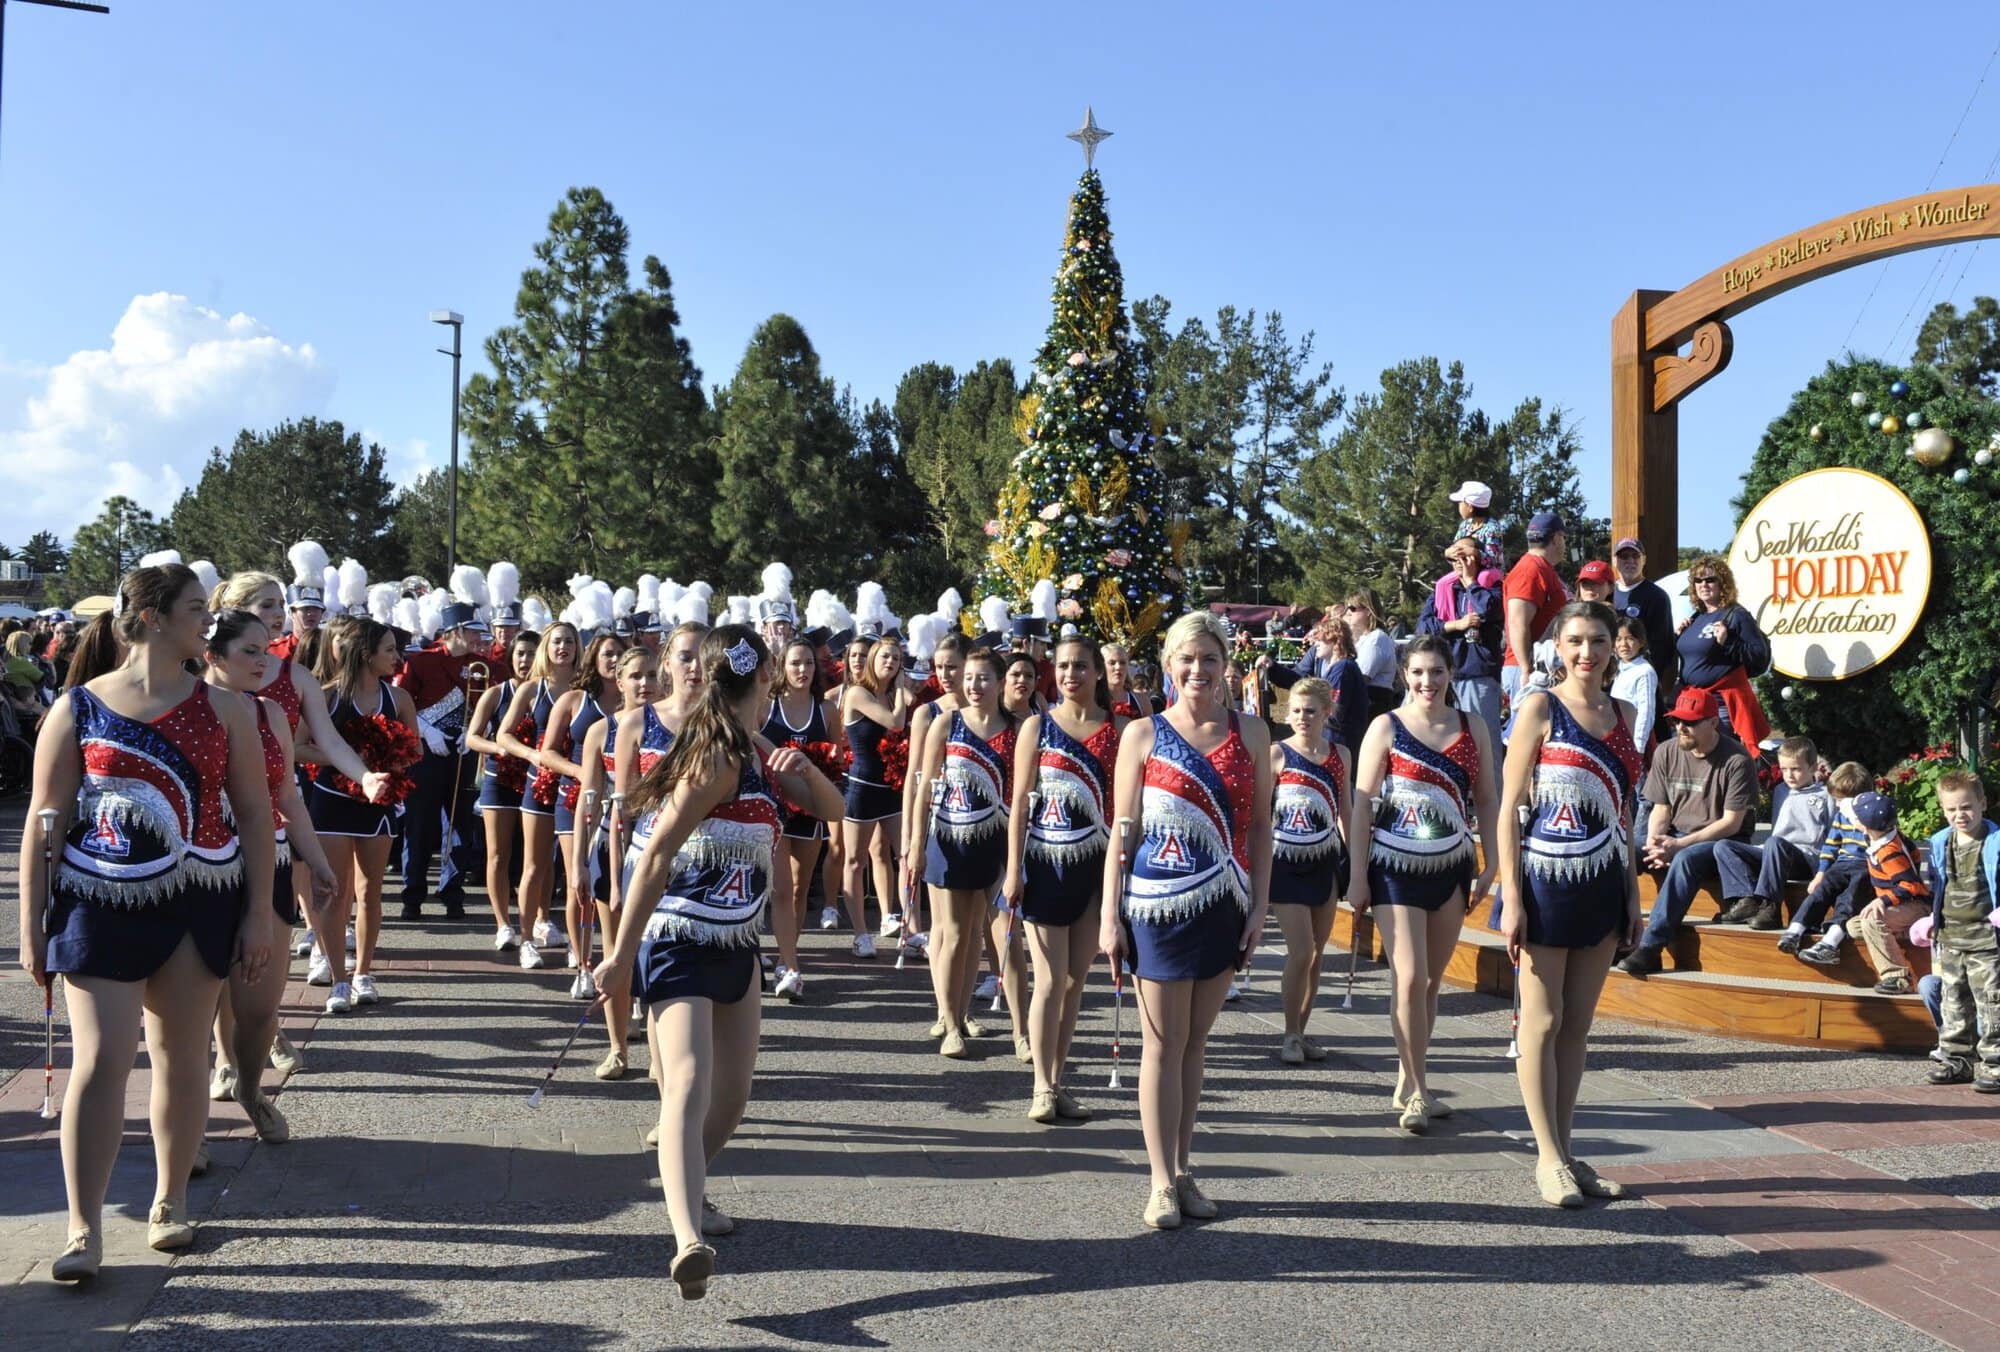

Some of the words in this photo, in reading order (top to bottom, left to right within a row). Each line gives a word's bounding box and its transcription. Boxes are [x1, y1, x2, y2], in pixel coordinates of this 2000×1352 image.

[1721, 264, 1762, 294] Hope
[1777, 237, 1830, 268] Believe
[1849, 212, 1893, 242] Wish
[1912, 194, 1990, 228] Wonder
[1745, 512, 1863, 563] SeaWorld's
[1771, 551, 1909, 604] HOLIDAY
[1757, 595, 1896, 637] Celebration
[1540, 801, 1588, 839] A
[1146, 823, 1196, 873] A
[703, 857, 756, 908] A
